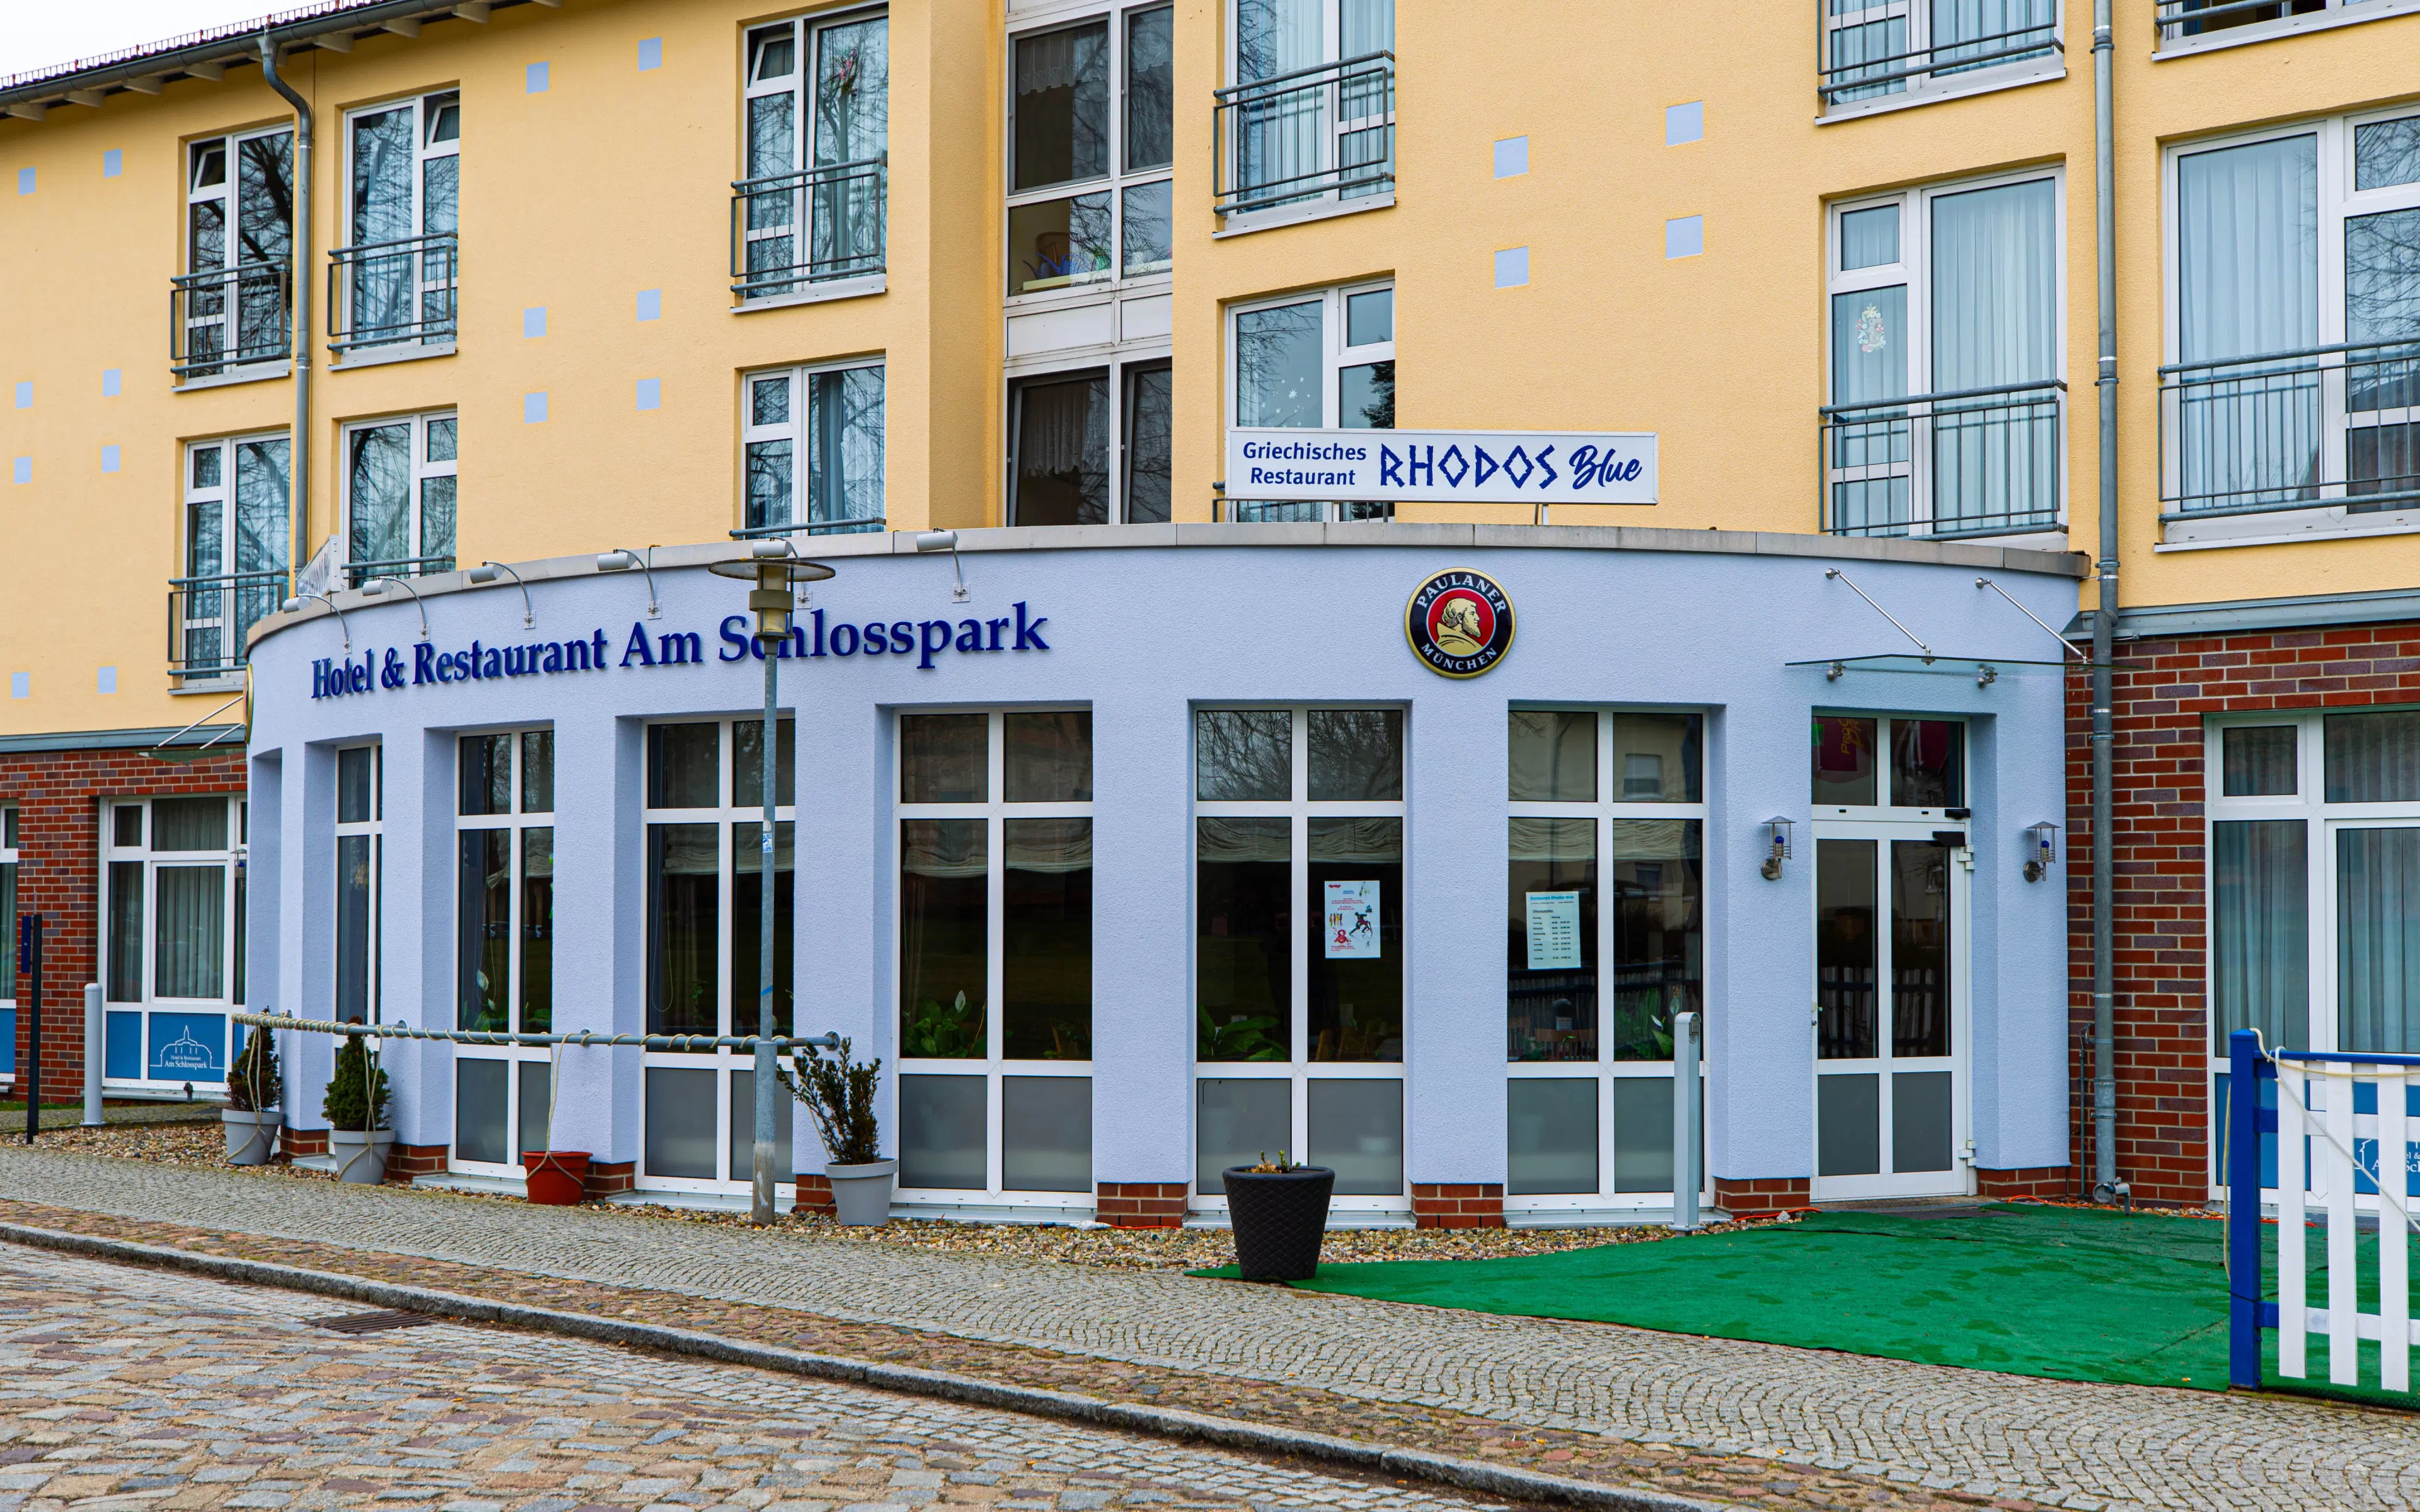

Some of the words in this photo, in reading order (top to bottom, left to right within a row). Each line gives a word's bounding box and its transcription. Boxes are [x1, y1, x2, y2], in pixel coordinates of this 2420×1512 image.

[1243, 441, 1367, 461] Griechisches
[1380, 442, 1558, 490] RHODOS
[1568, 444, 1644, 490] Blue
[1250, 466, 1356, 486] Restaurant
[1416, 573, 1507, 614] PAULANER
[311, 648, 374, 699] Hotel
[380, 646, 406, 689] &
[412, 627, 608, 685] Restaurant
[619, 621, 704, 668] Am
[1420, 643, 1499, 671] MÜNCHEN
[175, 1060, 208, 1070] Schlosspark
